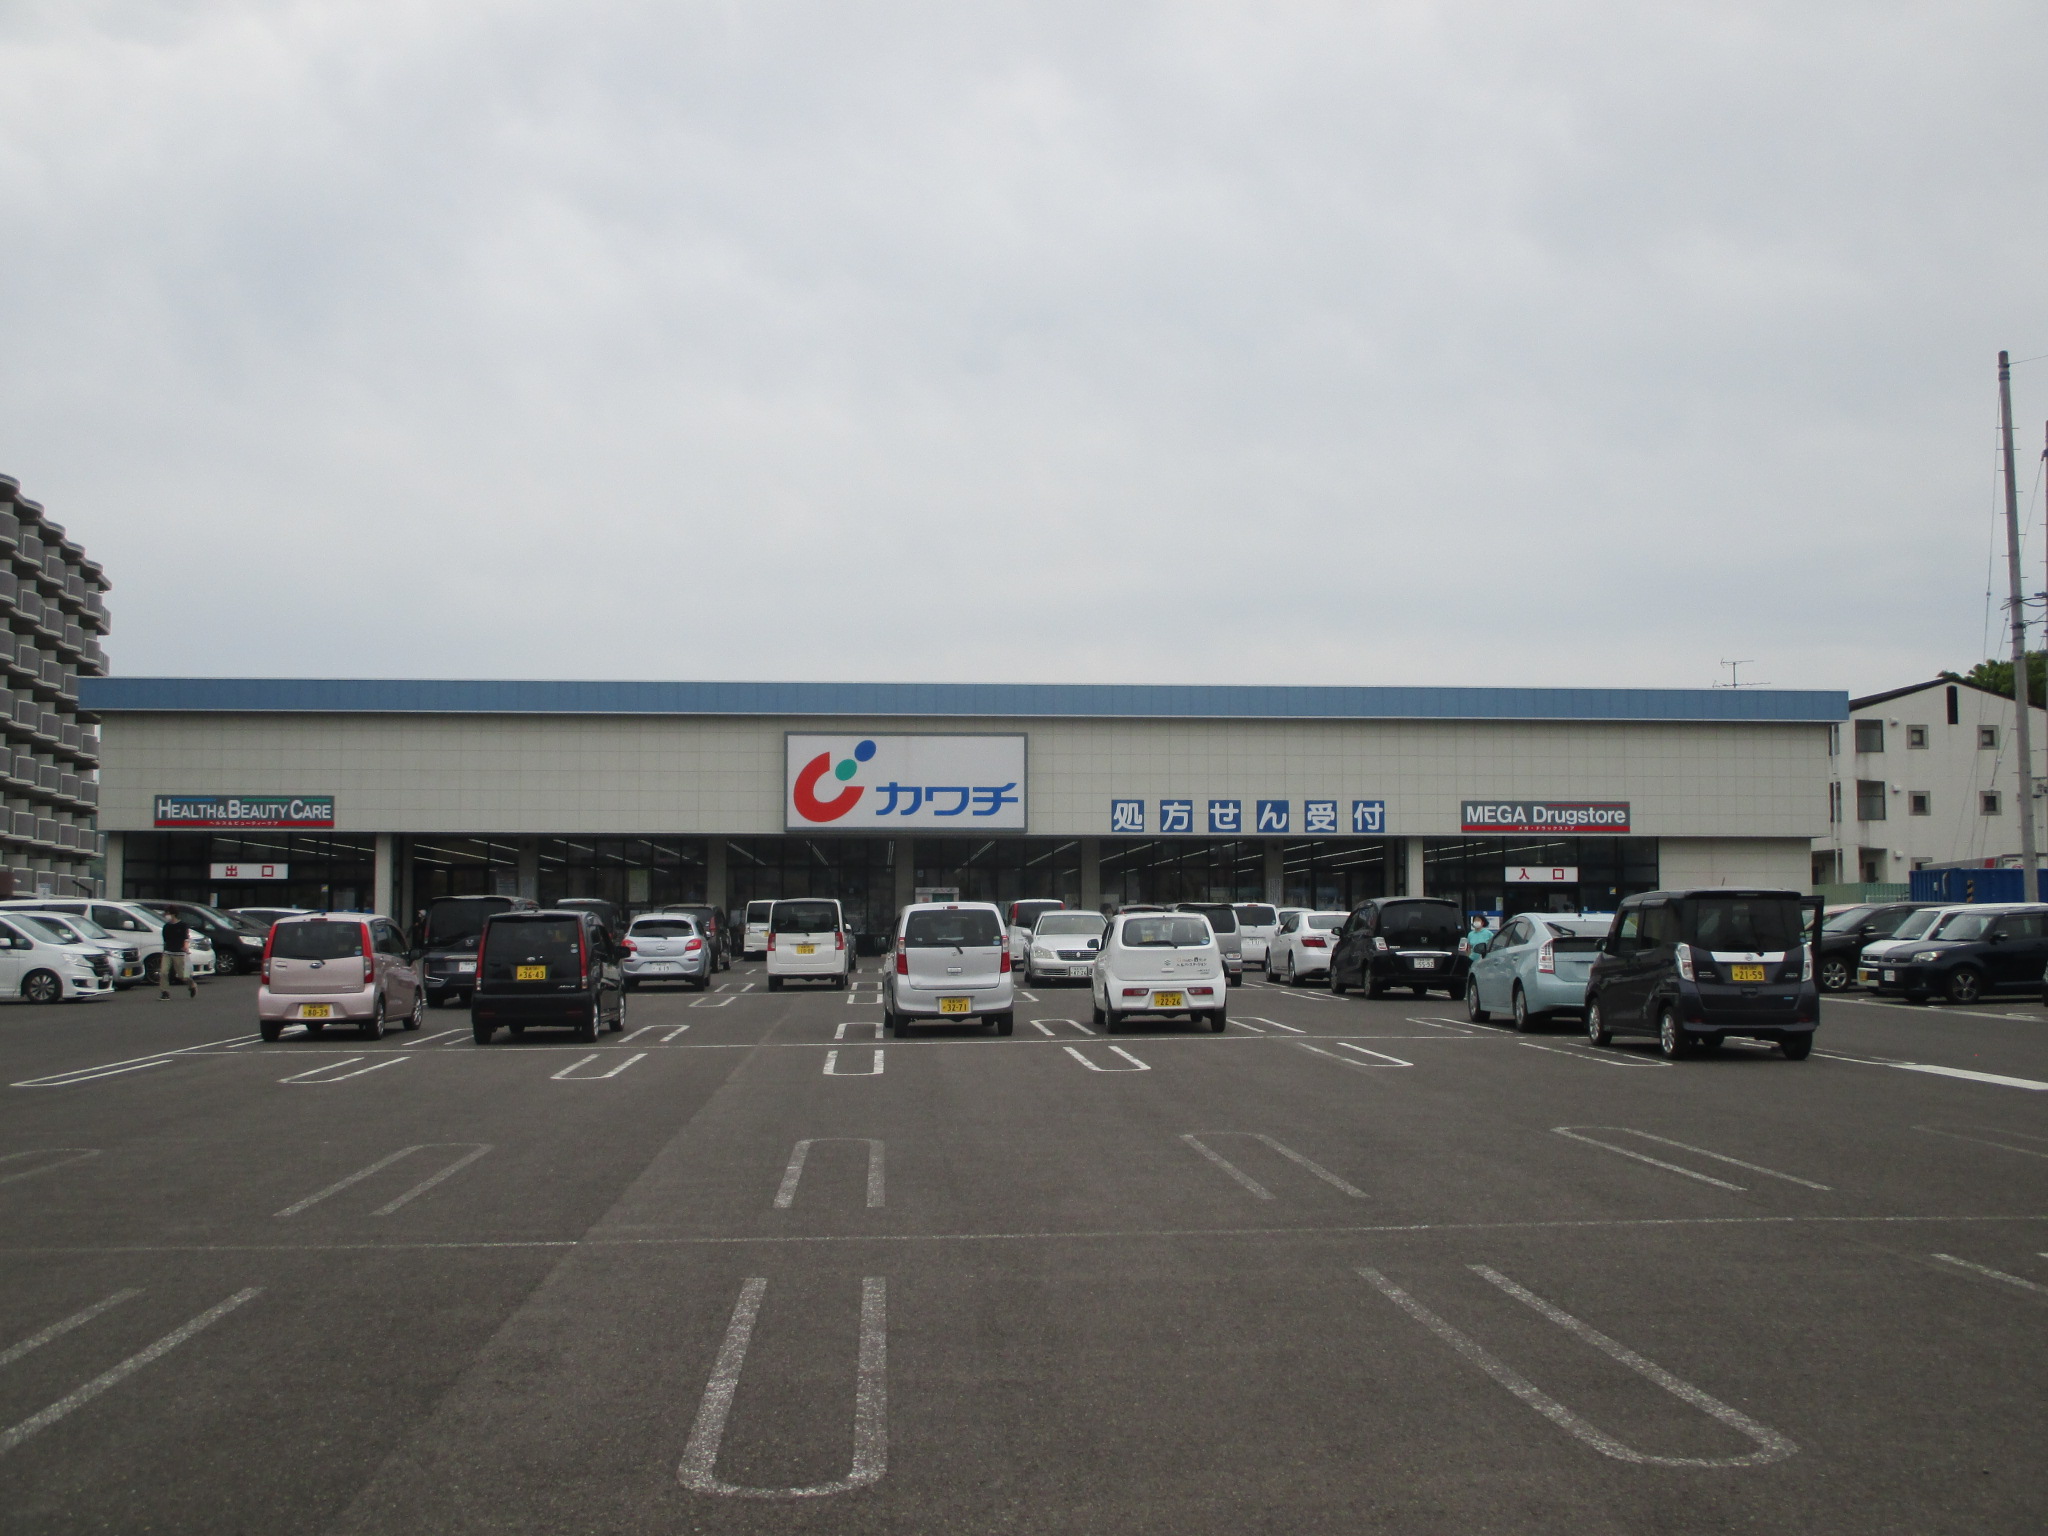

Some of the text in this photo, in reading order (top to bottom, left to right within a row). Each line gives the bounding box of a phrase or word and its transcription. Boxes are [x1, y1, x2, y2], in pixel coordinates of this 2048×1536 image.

[875, 782, 1019, 816] カワチ
[290, 799, 332, 819] CARE
[1466, 805, 1626, 825] MEGA Drugstore
[1112, 801, 1384, 831] 処方せん受付
[225, 865, 274, 877] 出口
[1519, 868, 1565, 880] 入口
[523, 970, 545, 979] 36-43
[1740, 970, 1763, 980] 21-59
[947, 1003, 967, 1012] 32-71
[1160, 998, 1181, 1006] 22-26
